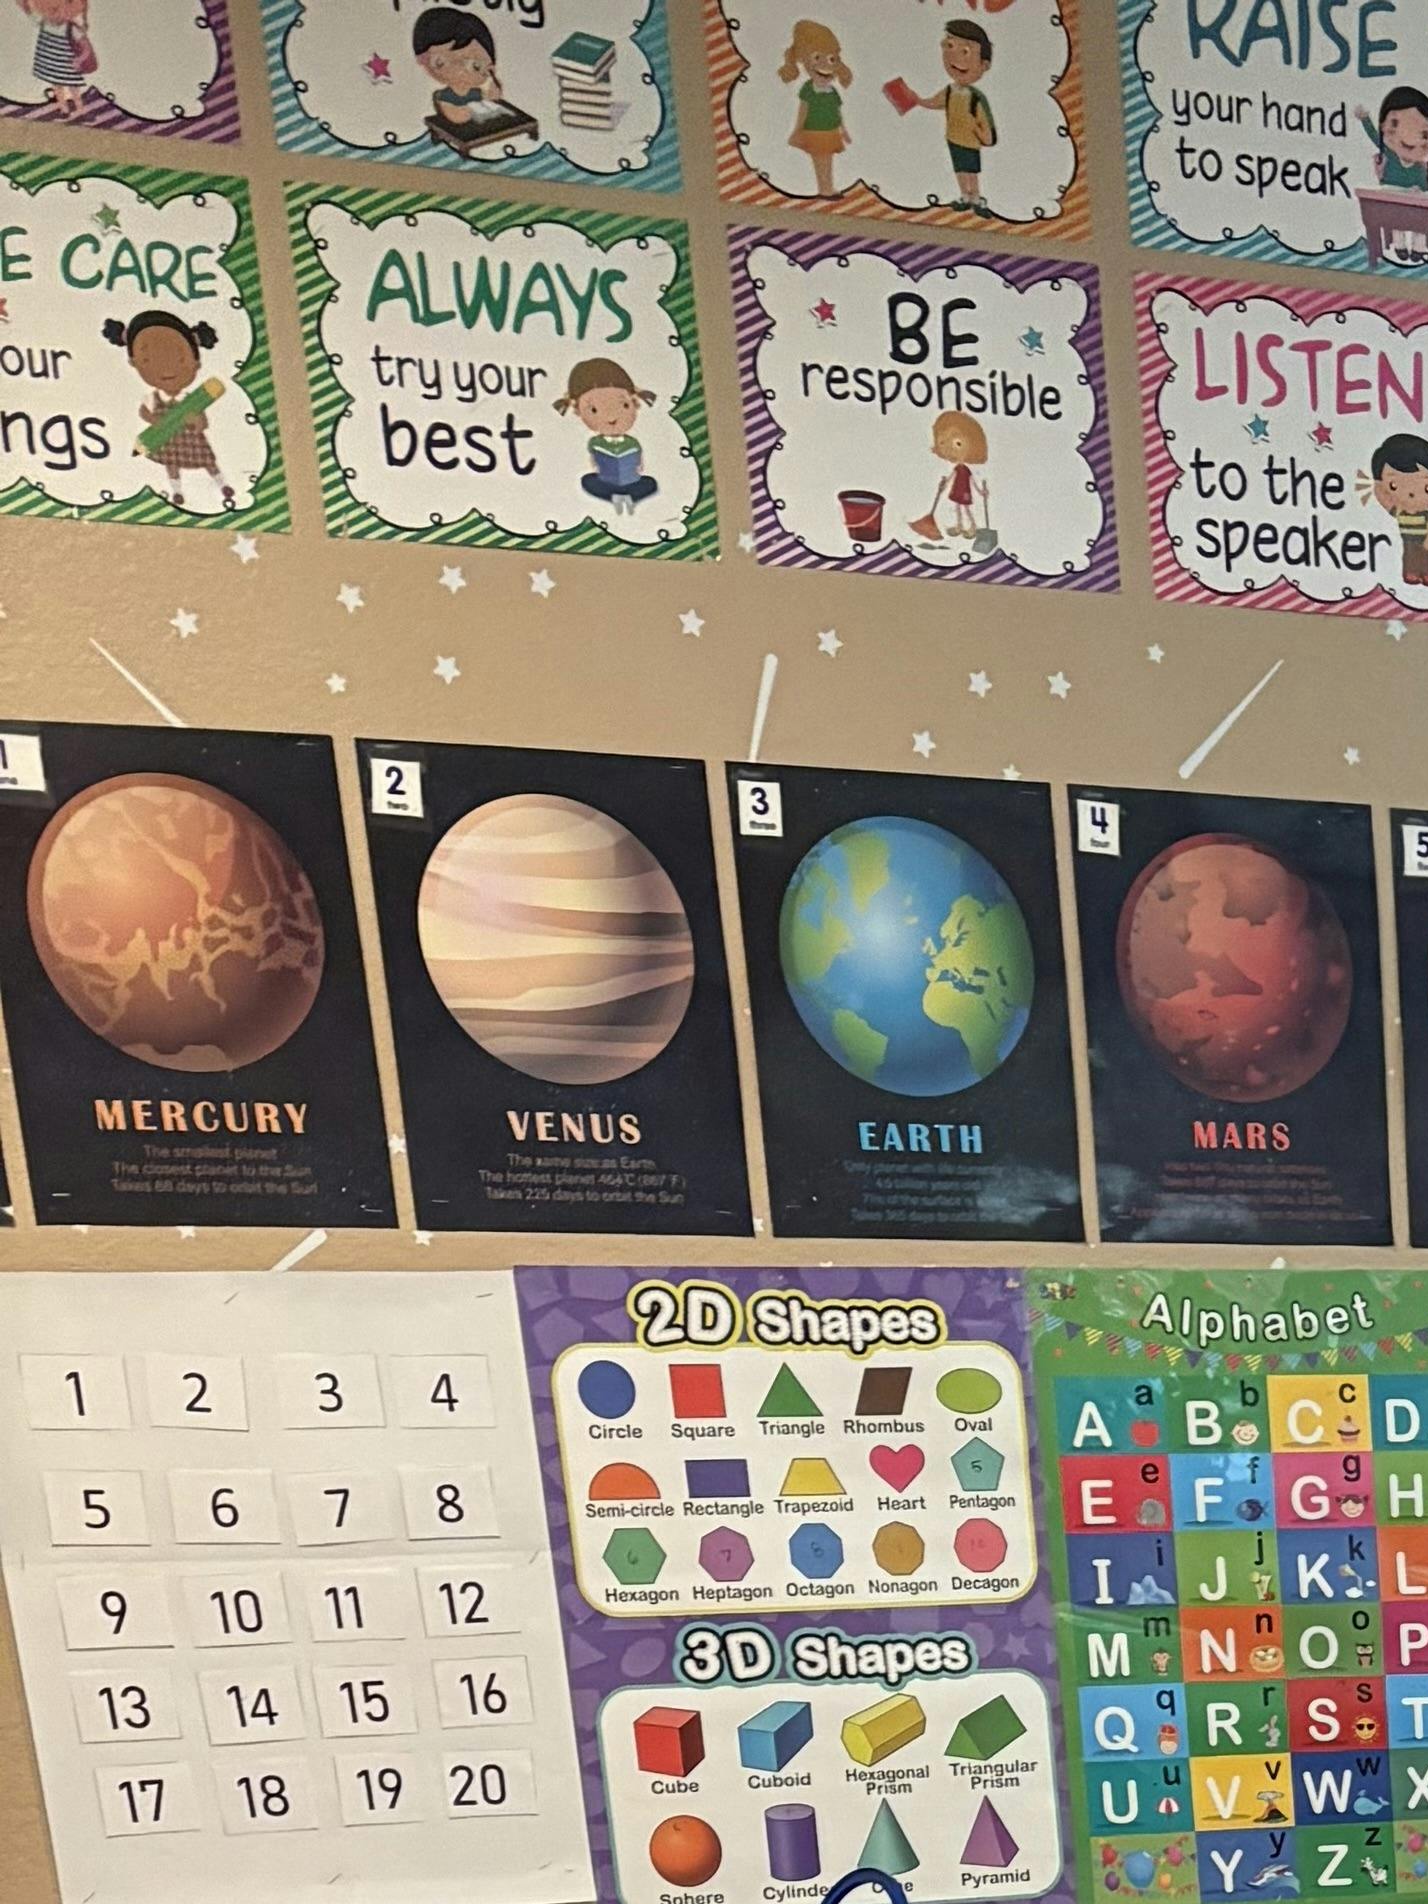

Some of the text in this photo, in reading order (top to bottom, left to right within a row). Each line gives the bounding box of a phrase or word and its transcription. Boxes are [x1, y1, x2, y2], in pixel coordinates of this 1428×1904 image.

[1189, 0, 1398, 77] RAISE
[1172, 88, 1348, 138] your hand
[1176, 137, 1352, 198] to speak
[61, 233, 219, 302] CARE
[367, 249, 633, 343] ALWAYS
[887, 291, 979, 368] BE
[372, 347, 547, 402] try your
[801, 361, 1063, 420] responsible
[1194, 327, 1424, 423] LISTEN
[381, 403, 537, 475] best
[1190, 451, 1345, 510] to the
[1195, 516, 1391, 574] speaker
[94, 1099, 308, 1135] MERCURY
[505, 1109, 642, 1145] VENUS
[858, 1120, 982, 1153] EARTH
[1193, 1120, 1290, 1151] MARS
[635, 1287, 940, 1353] 2D Shapes
[1142, 1292, 1375, 1348] Alphabet
[589, 1418, 992, 1439] Circle Square Triangle Rhombus Oval
[585, 1494, 1015, 1518] Semi-circle Rectangle Trapezoid Heart Pentagon
[605, 1574, 1019, 1604] Hexagon Heptagon Octagon Nonagon Decagon
[681, 1627, 971, 1688] 3D Shapes
[118, 1764, 505, 1824] 17 18 19 20
[651, 1773, 810, 1795] Cube Cuboid
[960, 1869, 1030, 1886] Pyramid
